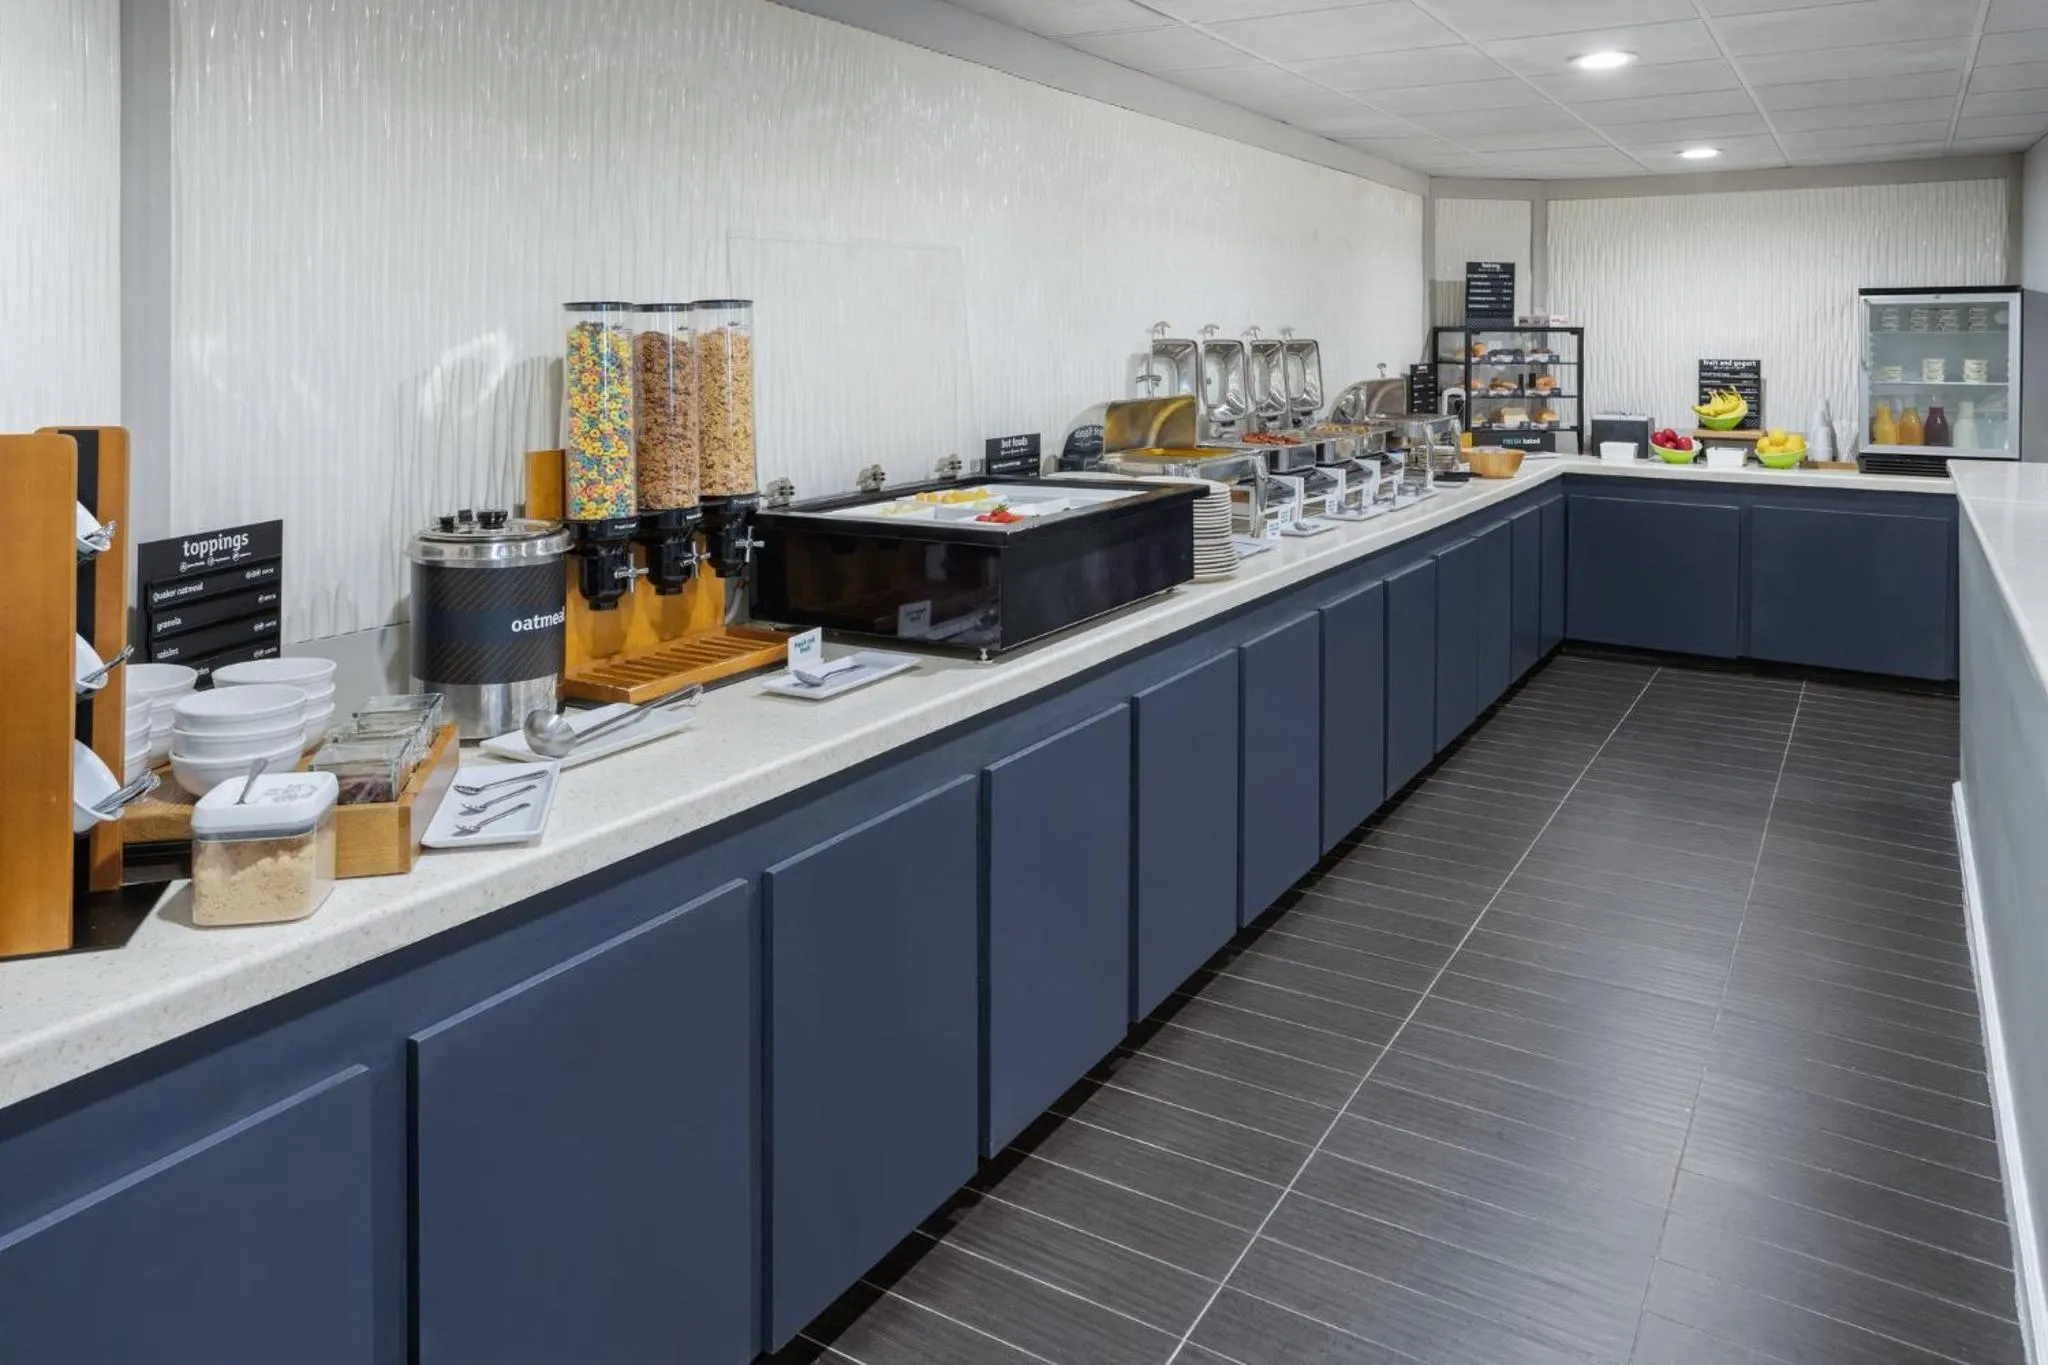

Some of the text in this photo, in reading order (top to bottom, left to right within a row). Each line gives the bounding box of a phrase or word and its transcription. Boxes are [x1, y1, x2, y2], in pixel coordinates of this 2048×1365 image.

[1734, 361, 1756, 369] yogurt
[182, 533, 249, 558] toppings
[152, 582, 204, 603] Quaker oatmeal
[156, 616, 182, 632] granola
